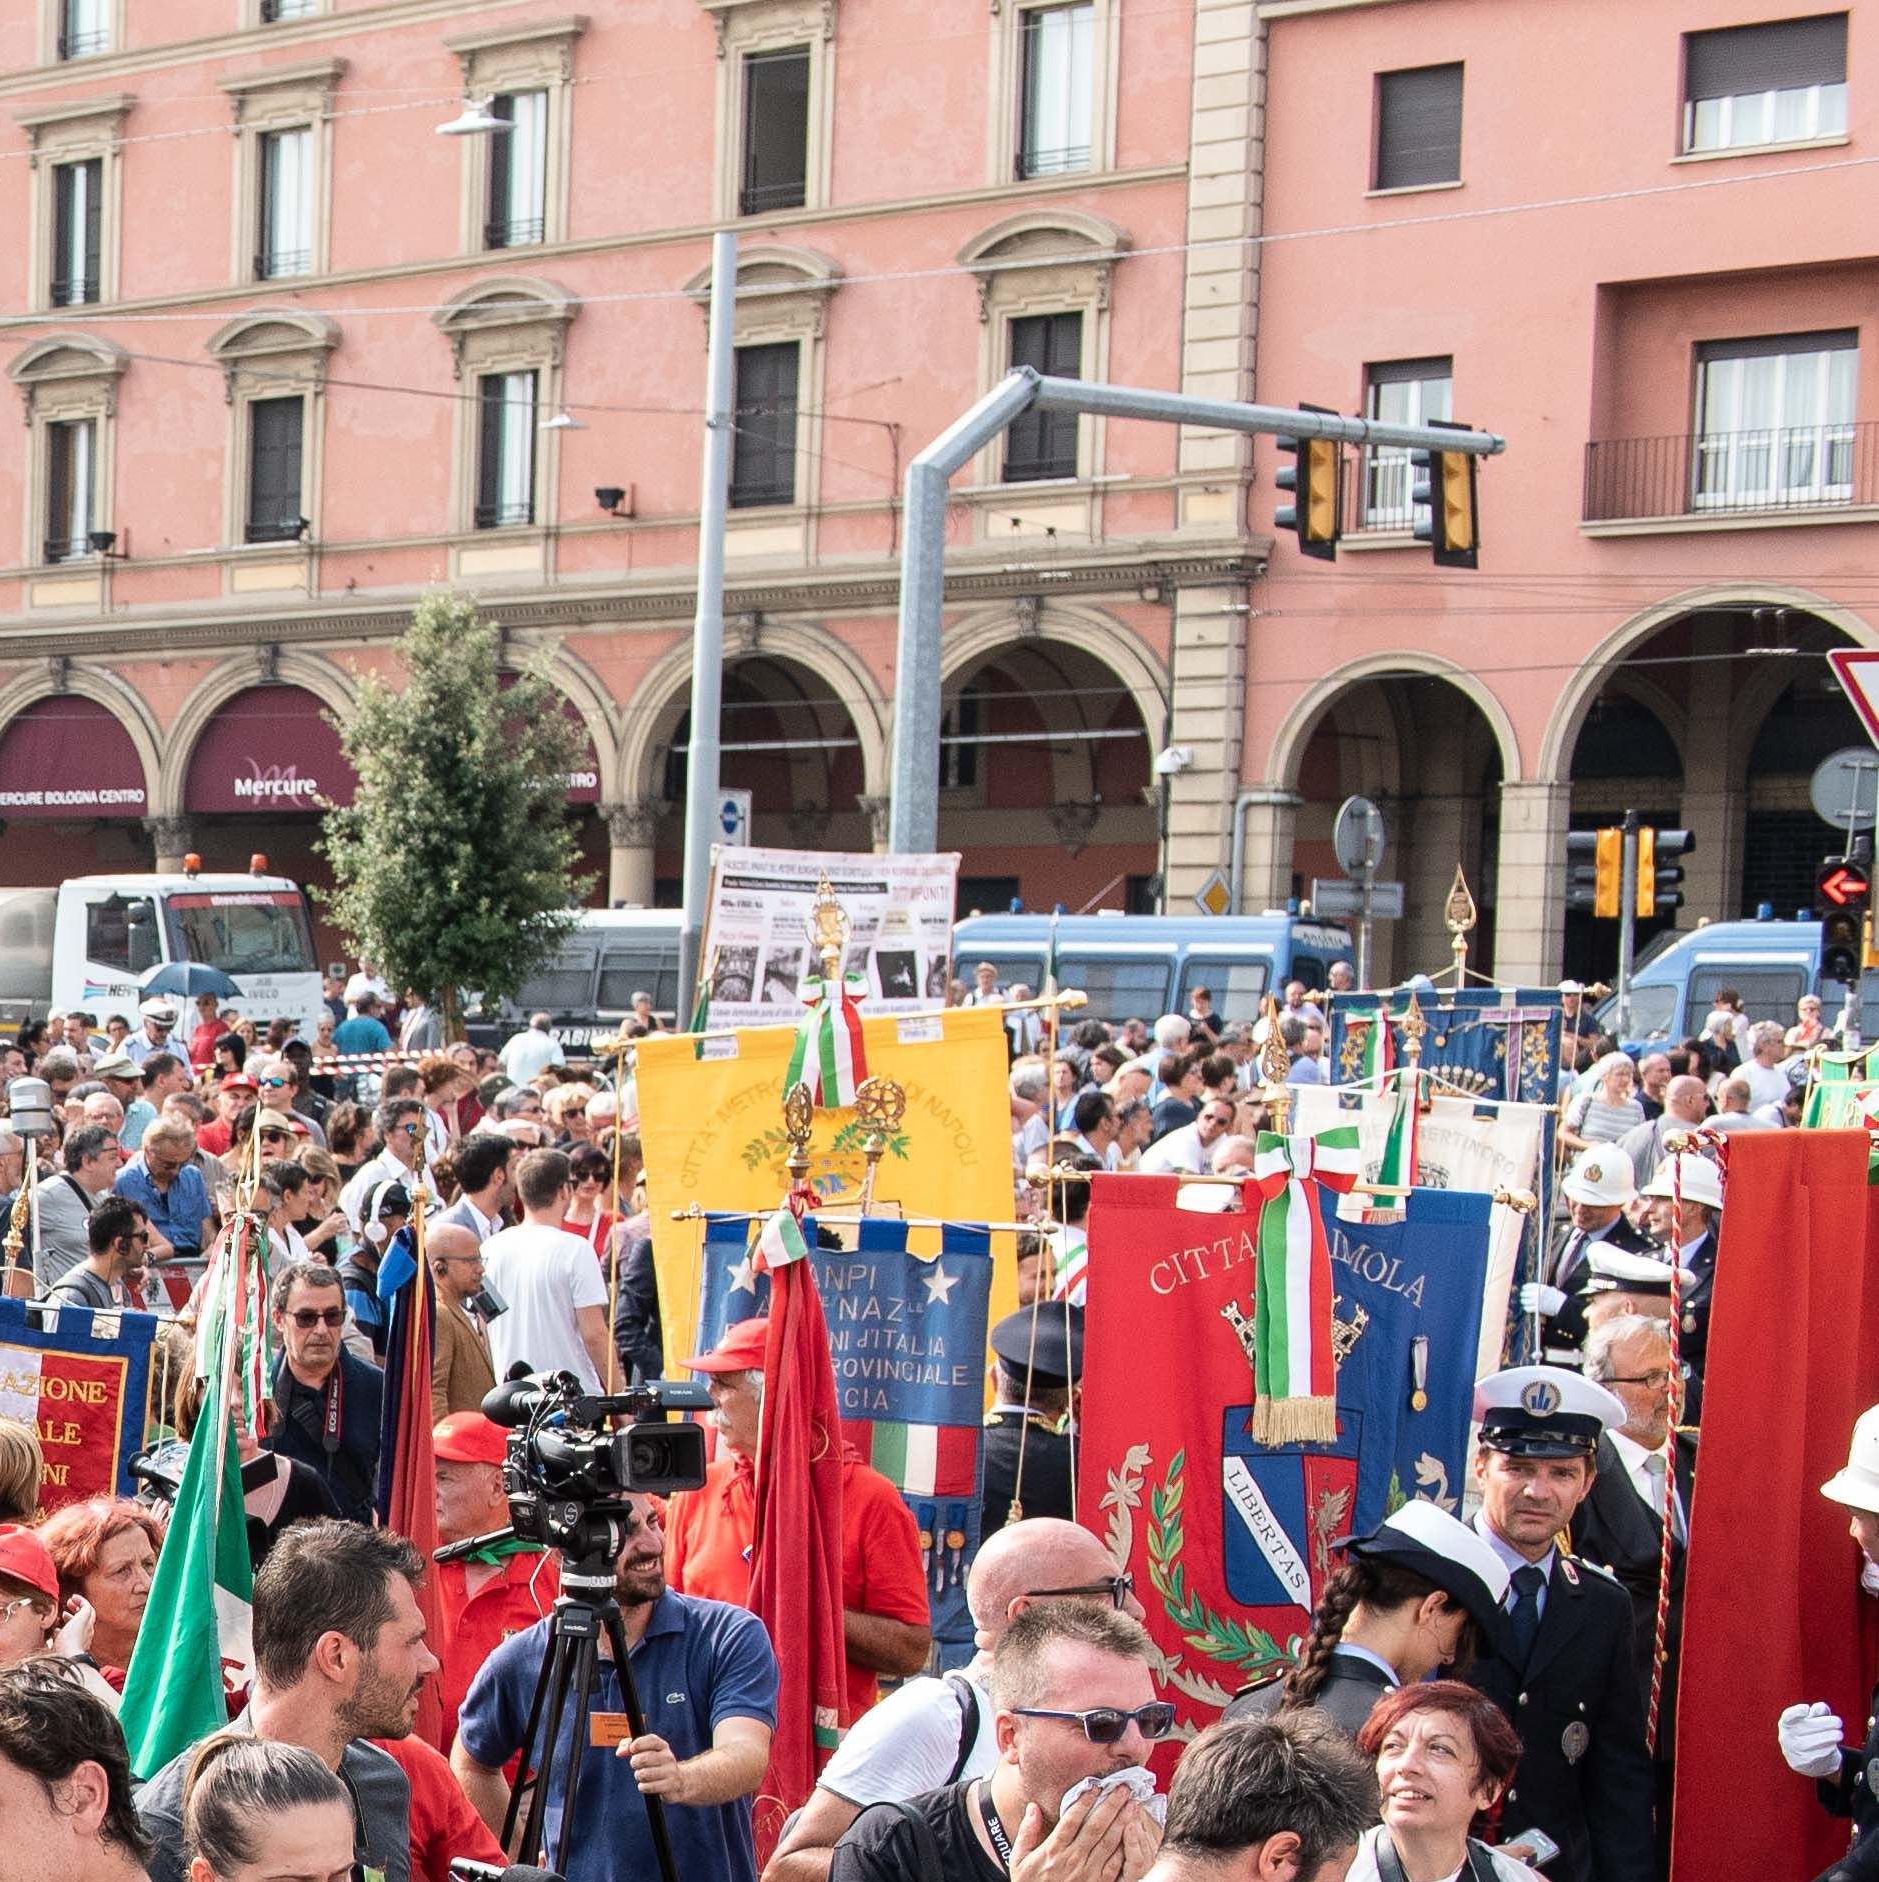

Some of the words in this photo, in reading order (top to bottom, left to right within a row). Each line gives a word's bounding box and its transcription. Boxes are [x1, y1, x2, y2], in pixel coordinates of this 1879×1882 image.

[44, 790, 98, 805] BOLOGNA
[99, 789, 145, 804] CENTRO
[234, 778, 318, 796] Mercure
[924, 1093, 979, 1168] NAPOLI
[1329, 1227, 1427, 1309] IMOLA
[328, 1410, 338, 1433] EOS
[1226, 1469, 1307, 1590] LIBERTAS
